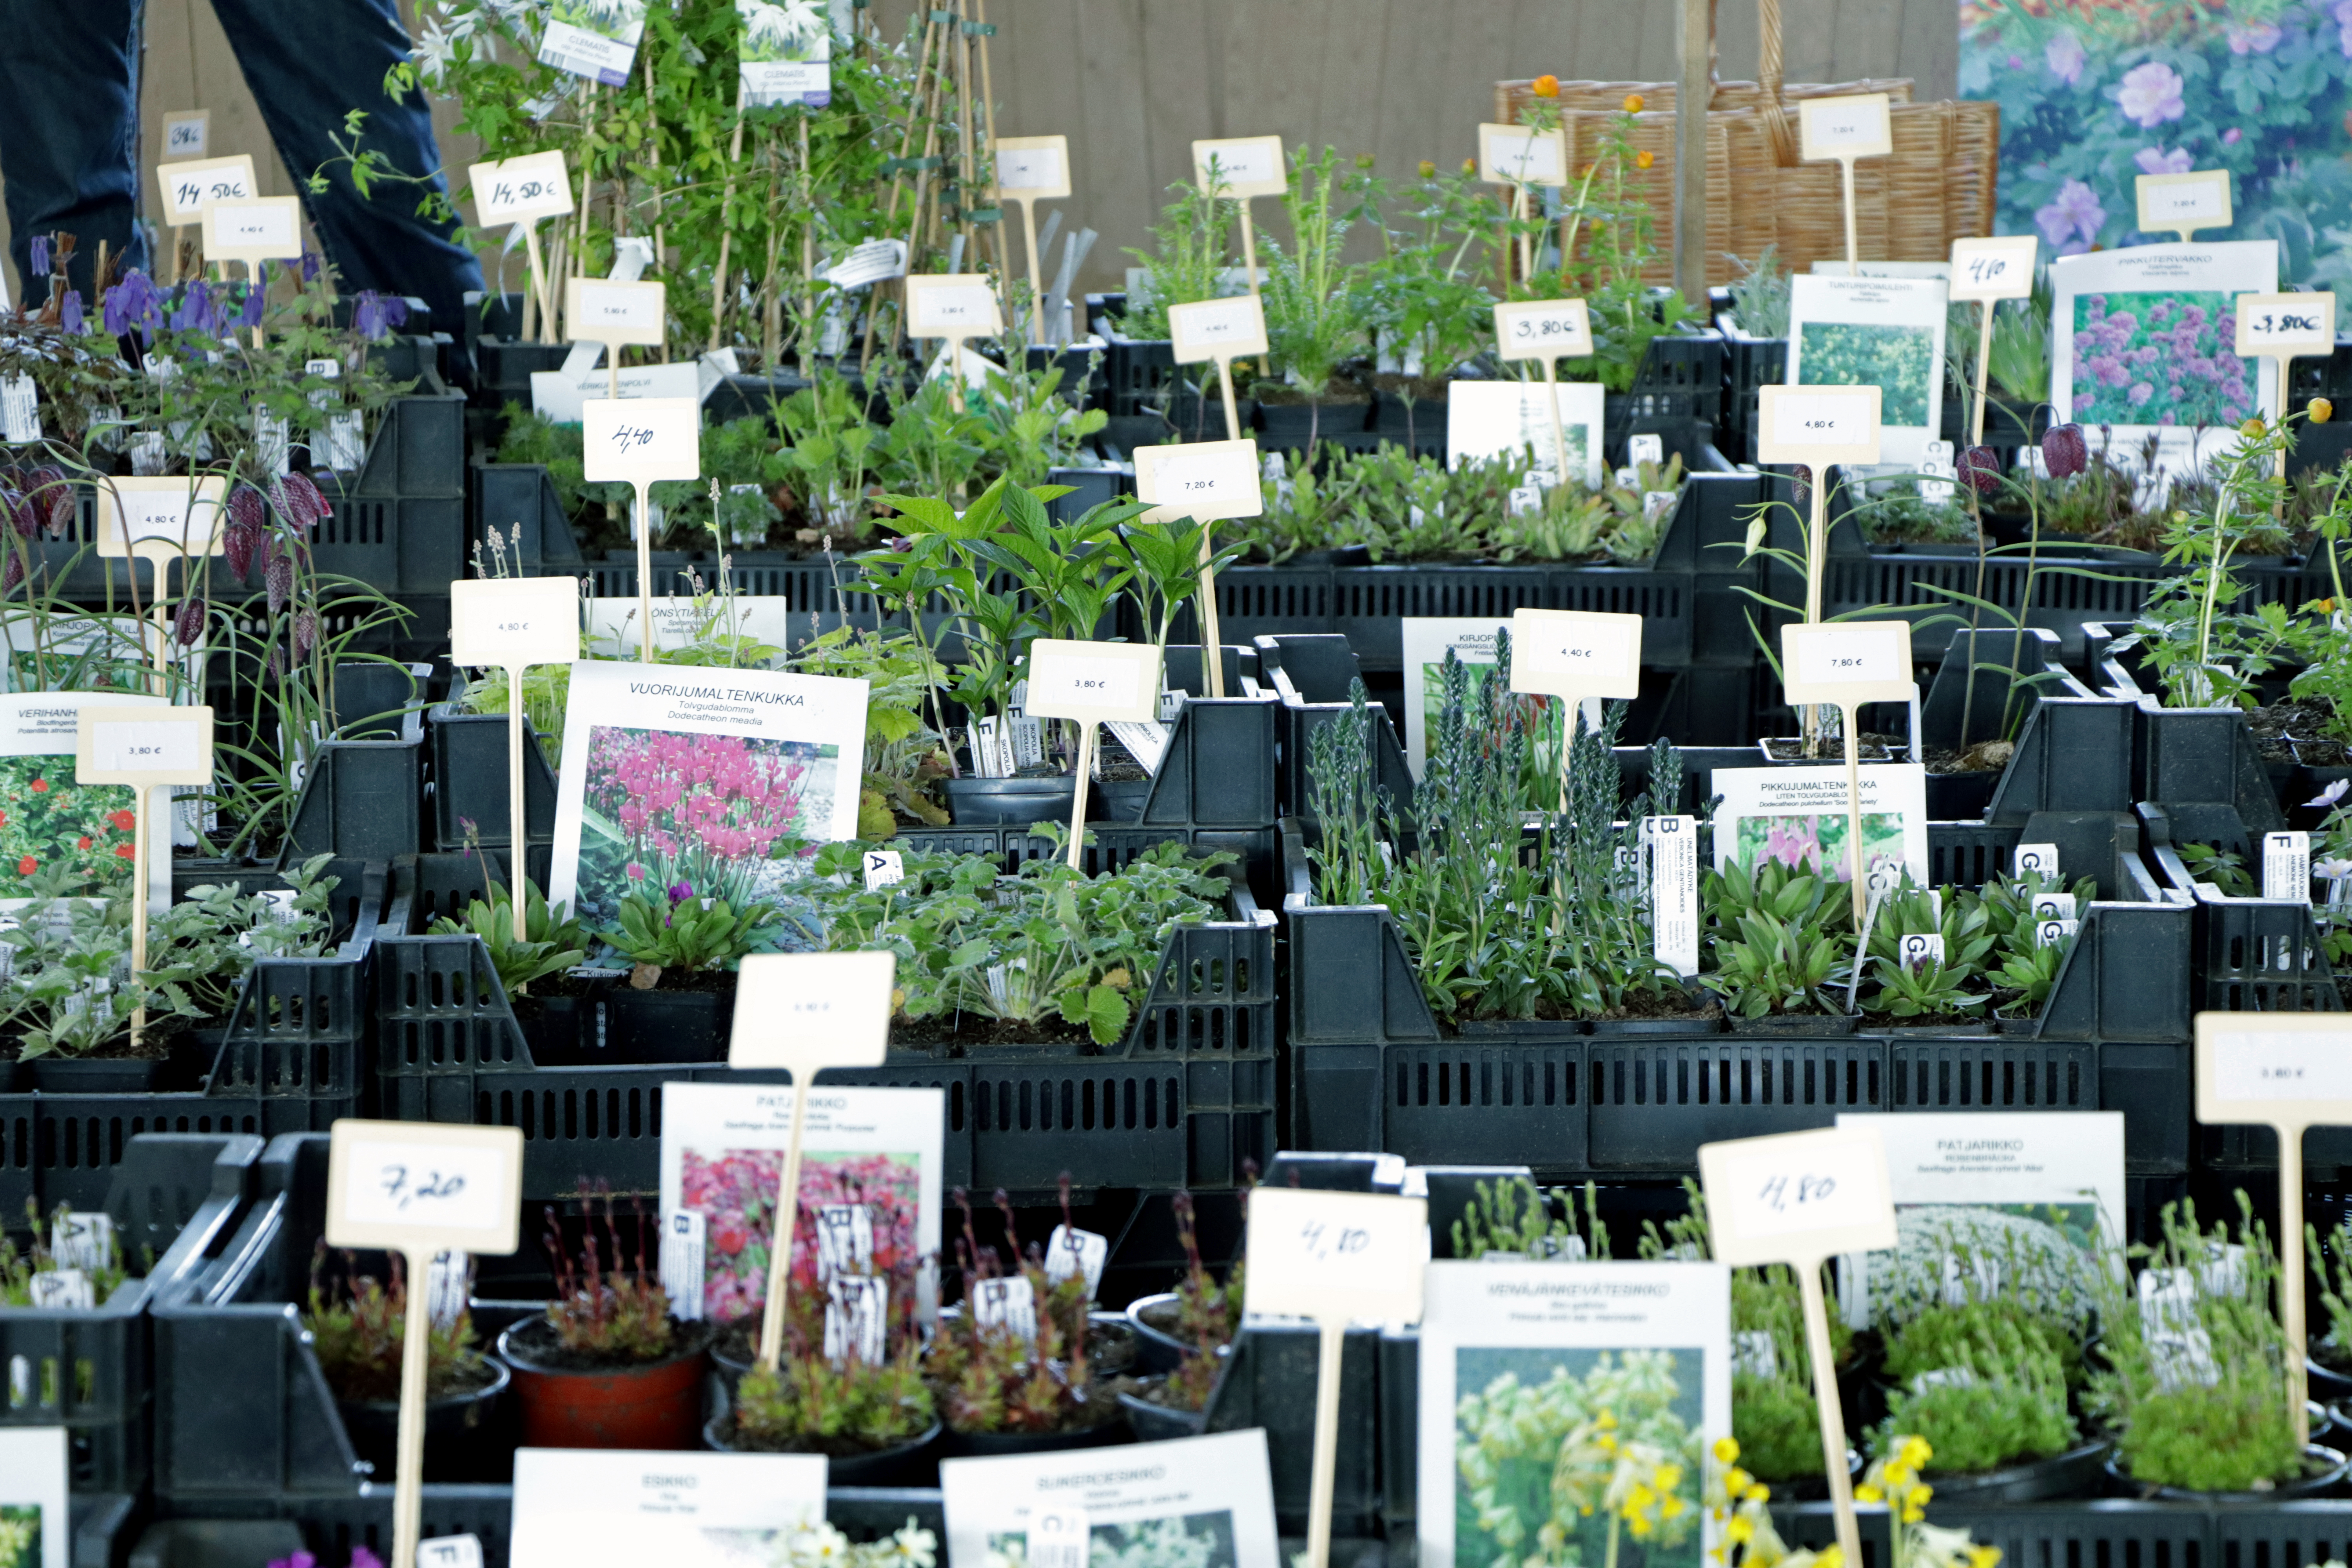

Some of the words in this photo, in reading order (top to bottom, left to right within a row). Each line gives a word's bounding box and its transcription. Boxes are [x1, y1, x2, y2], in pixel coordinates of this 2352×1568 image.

[569, 35, 610, 54] CLEMATIS
[764, 70, 806, 79] CLEMATIS
[2119, 254, 2212, 266] PIKKUTERVAKKO
[1829, 281, 1913, 292] TUNTURIPOIMULEHTI
[311, 363, 325, 373] B
[576, 379, 650, 391] VERIKUENPOLVI
[1805, 421, 1825, 429] 4,80
[612, 425, 654, 454] 4,40
[1635, 438, 1648, 447] A
[1928, 441, 1942, 453] C
[2117, 453, 2131, 465] A
[1923, 463, 1936, 474] C
[1530, 474, 1542, 483] A
[1622, 477, 1635, 486] A
[1185, 481, 1205, 490] 7,20
[1516, 491, 1528, 500] A
[146, 515, 166, 524] 4,80
[498, 622, 519, 632] 4,80
[1561, 648, 1582, 657] 4,40
[1831, 659, 1852, 668] 7,80
[1074, 680, 1095, 688] 3,80
[630, 682, 804, 707] VUORIJUMALTENKUKKA
[18, 708, 78, 718] VERIHANH
[679, 701, 755, 714] Tolvgudablomma
[1008, 707, 1022, 718] F
[668, 710, 726, 724] Dodecatheon
[730, 716, 763, 726] meadia
[978, 722, 992, 735] F
[1029, 723, 1038, 755] SKOPOLIA
[129, 747, 151, 756] 3,80
[1001, 739, 1011, 772] SKOPOLIA
[1761, 781, 1877, 792] PIKKUJUMALTENKKKA
[1661, 818, 1679, 833] B
[2272, 836, 2291, 848] F
[870, 854, 887, 871] A
[2022, 853, 2040, 869] G
[262, 891, 280, 907] A
[2044, 922, 2063, 941] G
[1907, 936, 1926, 953] G
[757, 1095, 847, 1109] PATJIKKO
[1937, 1138, 2024, 1152] PATJARIKKO
[381, 1163, 466, 1209] 7,20
[1760, 1174, 1837, 1214] 4,80
[674, 1215, 689, 1234] B
[1041, 1514, 1064, 1532] C
